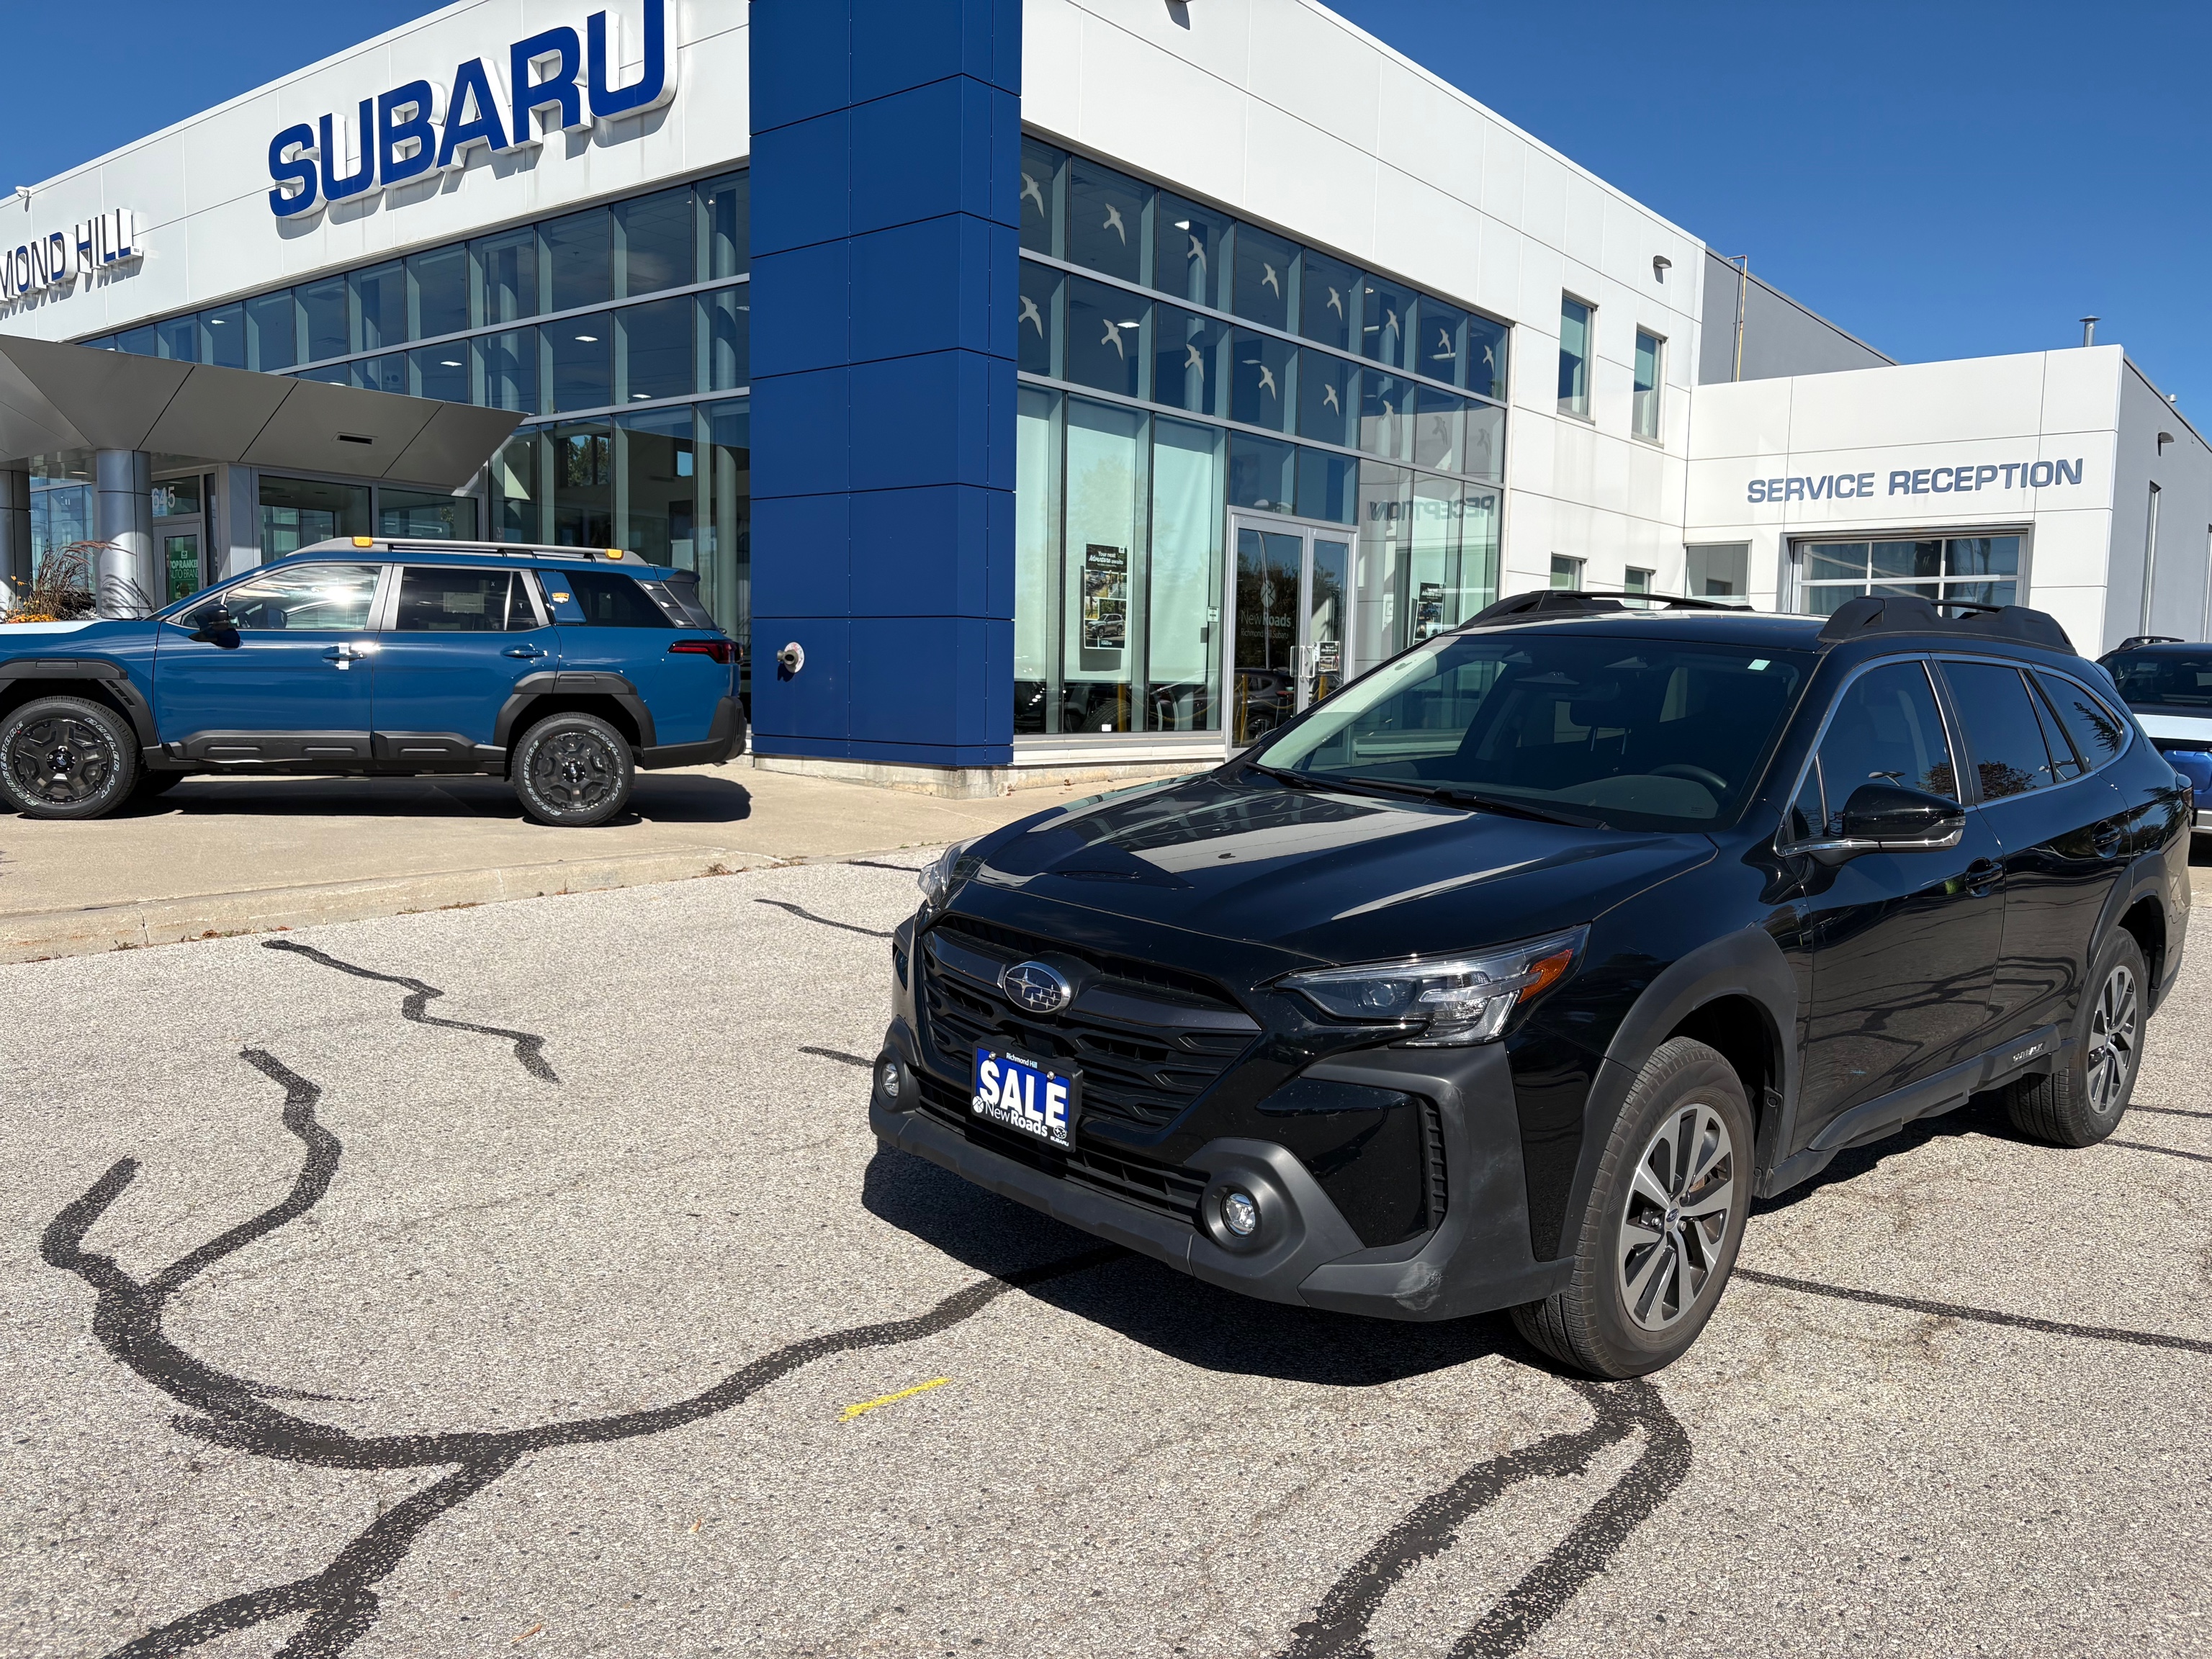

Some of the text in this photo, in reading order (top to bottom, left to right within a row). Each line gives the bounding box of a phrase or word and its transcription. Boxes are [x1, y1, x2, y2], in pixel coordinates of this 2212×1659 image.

[269, 0, 665, 217] SUBARU
[76, 208, 131, 273] HILL
[152, 486, 176, 508] 645
[1747, 458, 2083, 503] SERVICE RECEPTION
[1240, 627, 1264, 638] Richmond
[84, 717, 120, 771] DUELER
[523, 740, 562, 817] BRIDGESTONE
[1006, 1052, 1030, 1066] Richmond
[979, 1060, 1066, 1128] SALE
